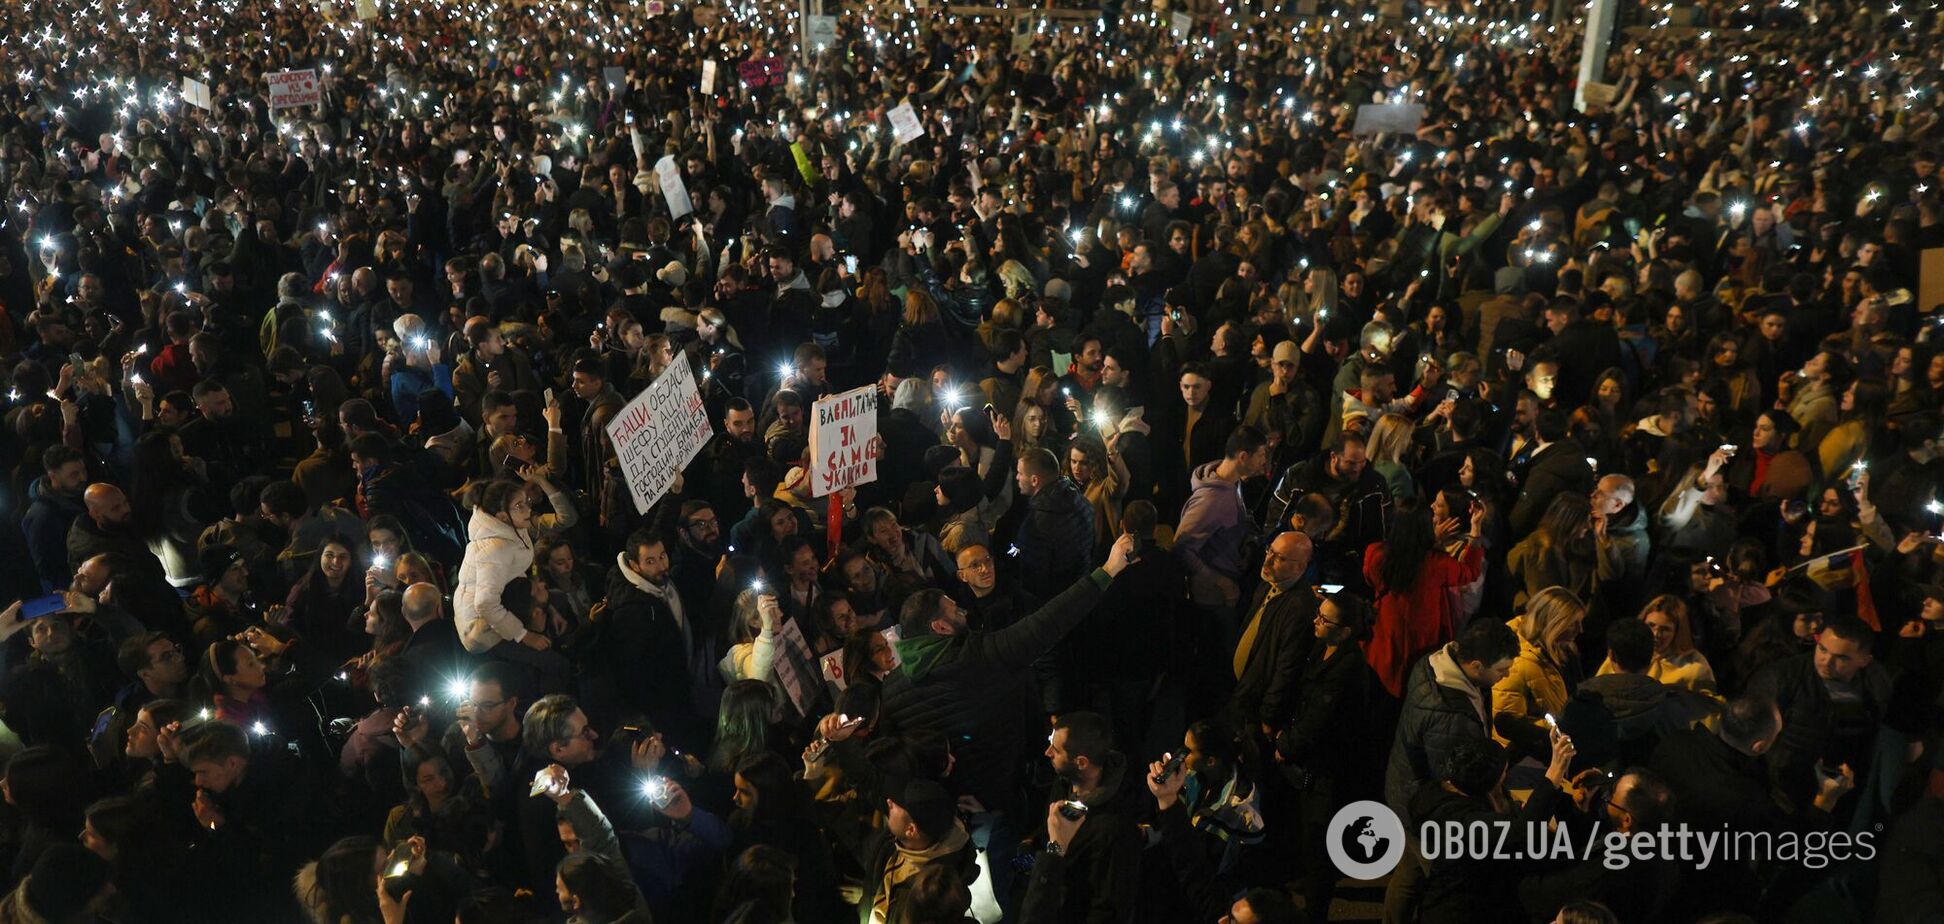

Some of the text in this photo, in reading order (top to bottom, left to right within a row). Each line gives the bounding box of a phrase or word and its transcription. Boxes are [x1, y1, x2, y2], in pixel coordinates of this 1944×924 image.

[622, 421, 657, 464] ШЕФУ
[630, 456, 650, 483] ДА
[651, 408, 689, 459] СТУДЕНТИ
[634, 409, 705, 497] ГОСПОДИН БРНАБА
[828, 437, 878, 471] САМ СЕ
[841, 425, 855, 447] ЈА
[643, 486, 656, 504] ПА
[655, 471, 667, 493] ДА
